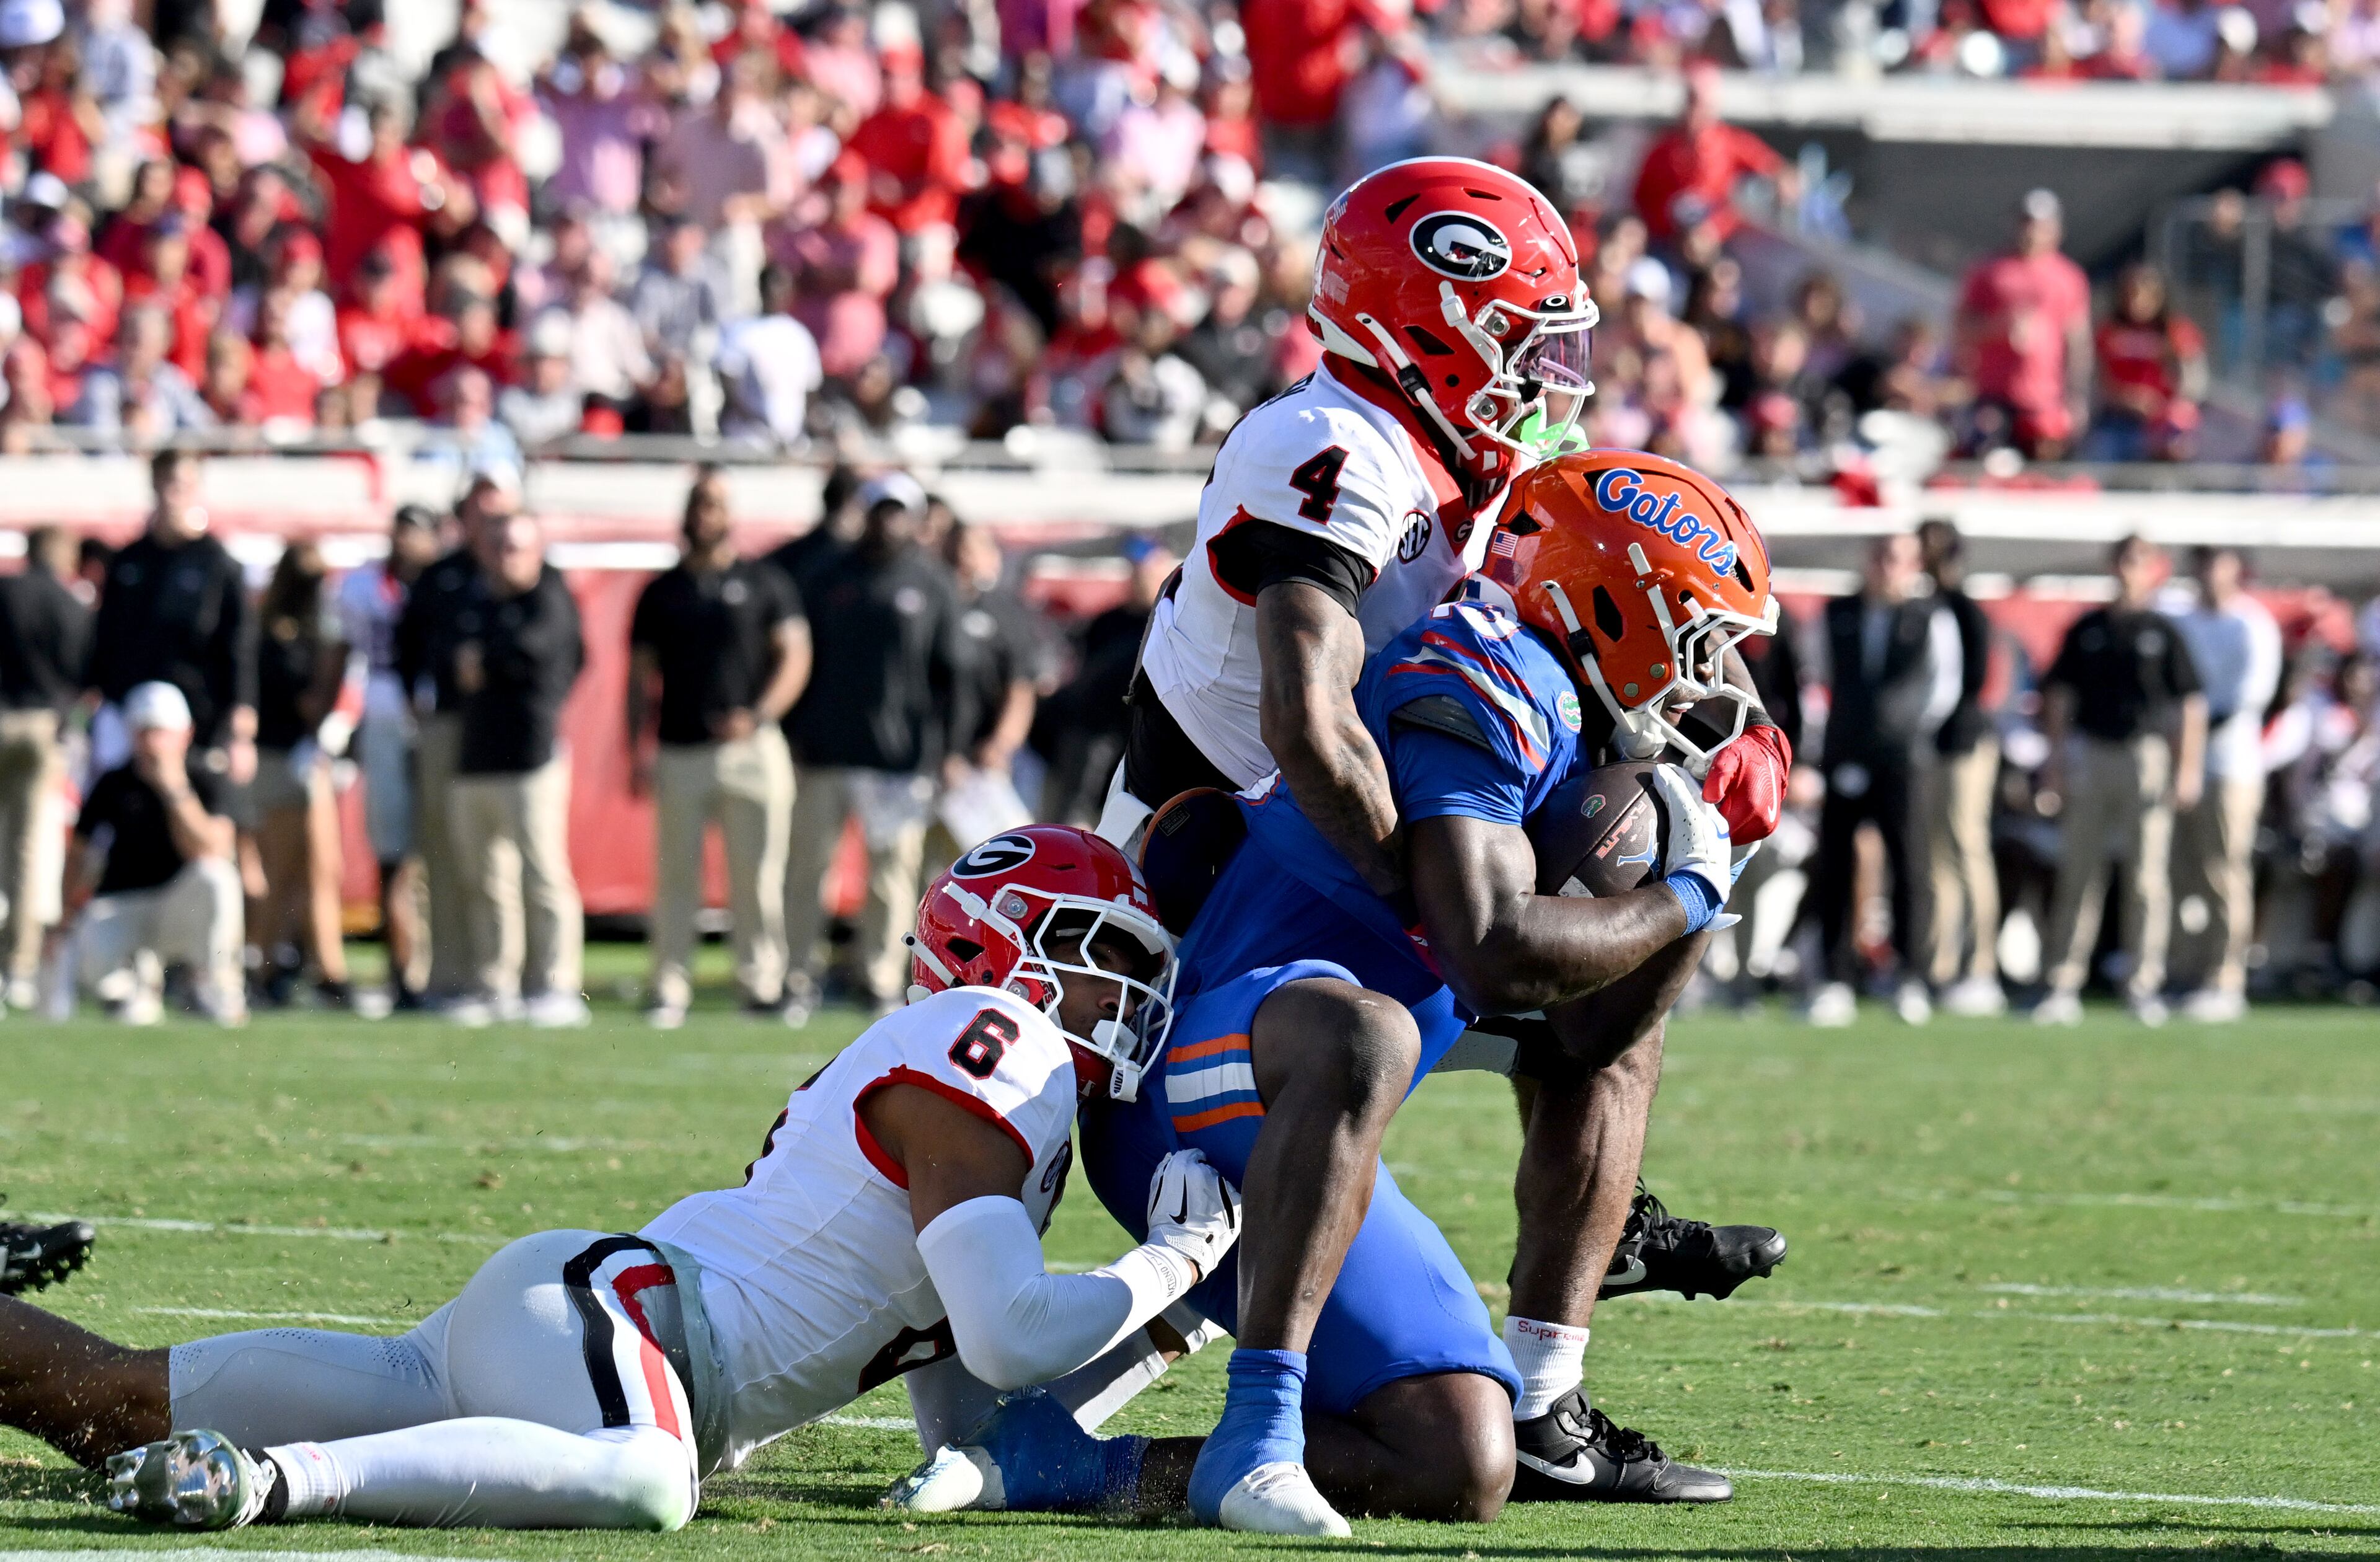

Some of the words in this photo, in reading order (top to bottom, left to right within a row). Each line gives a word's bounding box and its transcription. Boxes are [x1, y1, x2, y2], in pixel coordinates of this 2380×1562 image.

[1430, 222, 1510, 268] G
[1289, 444, 1350, 526] 4
[1399, 513, 1429, 560] SEC
[1457, 522, 1473, 539] G
[1595, 468, 1738, 577] Gators
[965, 838, 1034, 868] G
[948, 1008, 1021, 1080] 6
[1160, 1266, 1176, 1298] NXTRND
[1518, 1320, 1585, 1341] Supreme
